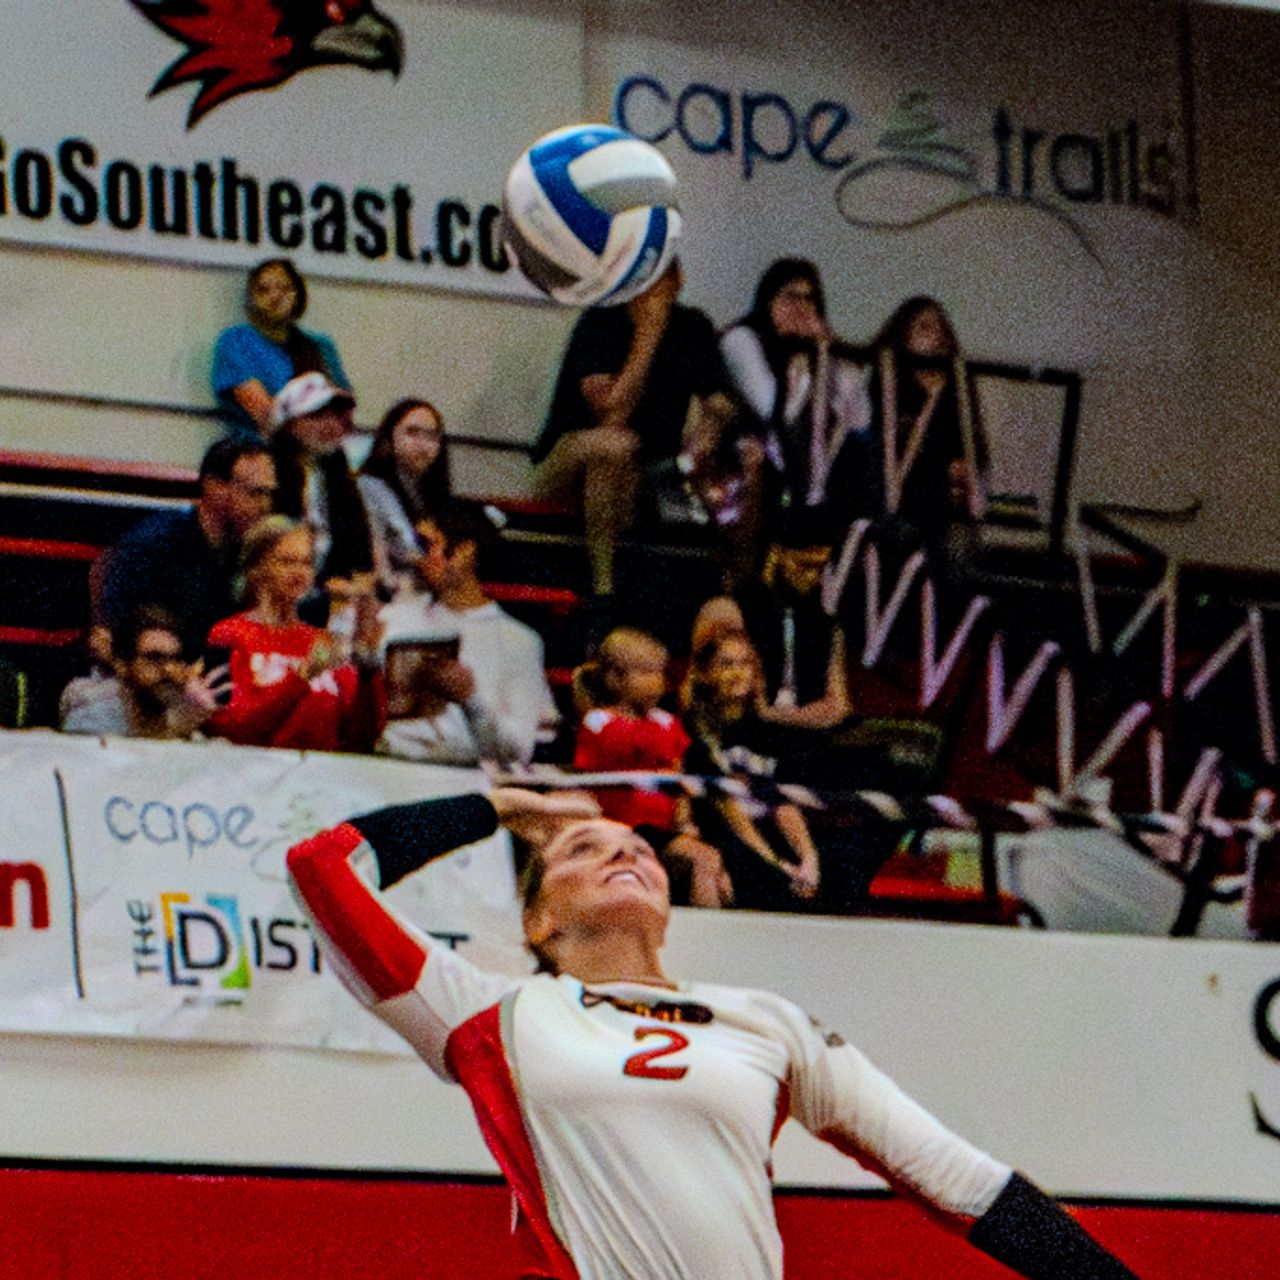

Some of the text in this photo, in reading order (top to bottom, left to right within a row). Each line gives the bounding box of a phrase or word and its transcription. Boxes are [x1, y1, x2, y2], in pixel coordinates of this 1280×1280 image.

[613, 75, 1178, 218] cape trails
[104, 796, 260, 858] cape
[127, 899, 161, 976] THE
[623, 1026, 690, 1081] 2
